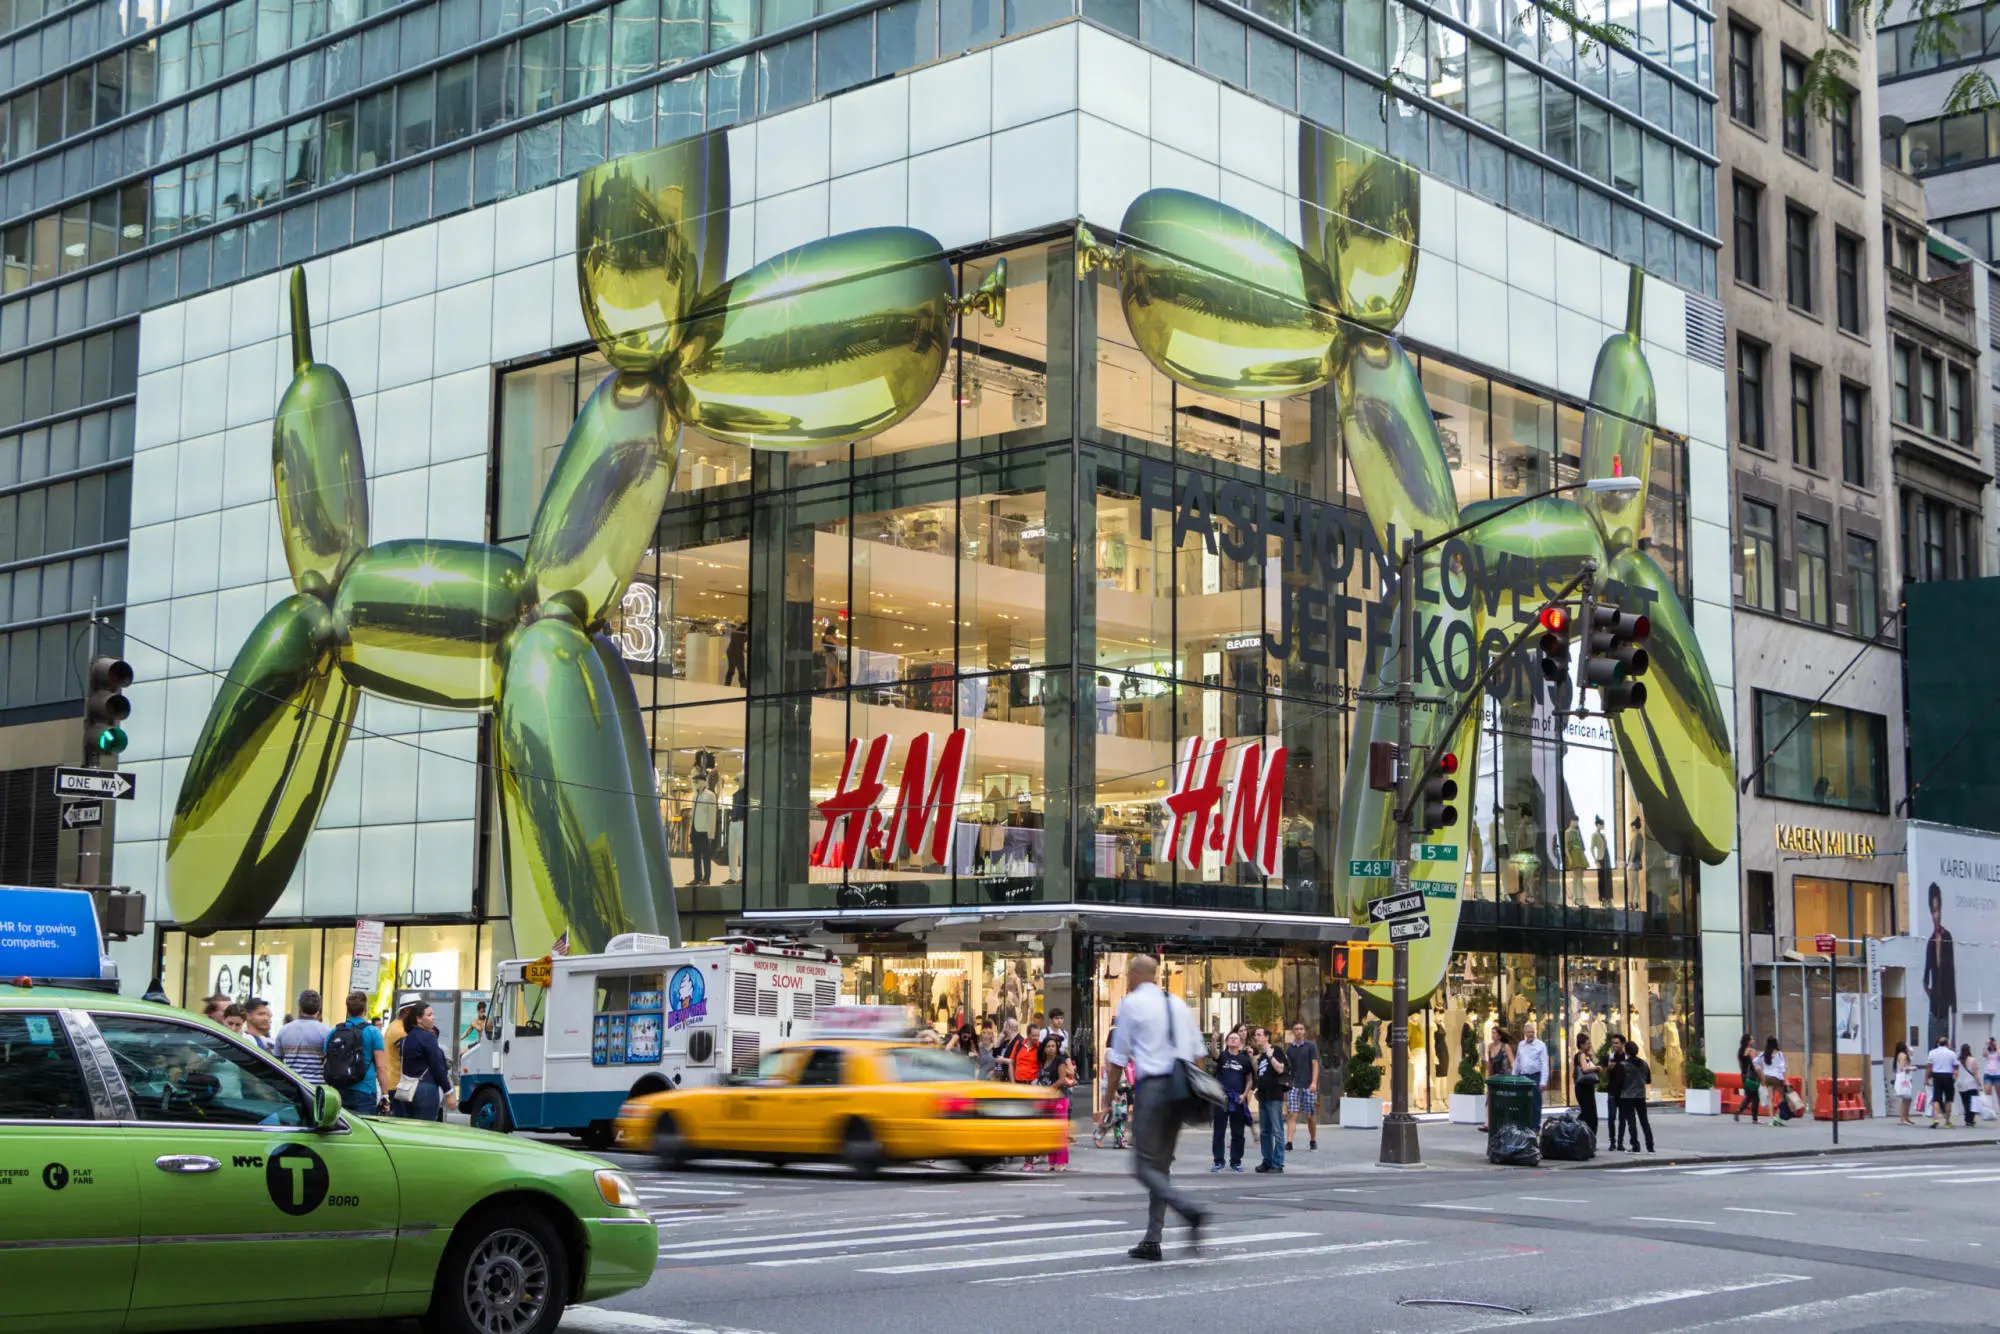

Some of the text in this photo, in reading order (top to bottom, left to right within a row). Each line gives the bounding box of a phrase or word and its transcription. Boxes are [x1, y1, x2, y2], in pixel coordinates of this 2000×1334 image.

[1140, 459, 1397, 600] FASHION
[1265, 581, 1393, 676] JEFF
[1226, 637, 1261, 650] ELEVATOR
[1543, 715, 1552, 732] of
[67, 776, 125, 791] ONE WAY
[816, 727, 971, 870] H&M
[1161, 735, 1288, 876] H&M
[69, 808, 98, 822] ONE WAY
[1775, 824, 1876, 858] KAREN MILLEN
[1427, 847, 1437, 859] 5
[1353, 862, 1361, 875] E
[1364, 862, 1382, 876] 48
[1940, 857, 1972, 879] KAREN
[1410, 880, 1431, 893] WILLIAM
[1376, 899, 1418, 916] ONE WAY
[0, 921, 77, 937] HR for growing
[1392, 923, 1426, 936] ONE WAY
[1, 937, 60, 950] companies.
[531, 966, 551, 977] SLOW
[754, 960, 826, 976] WATCH FOR OUR CHILDREN
[771, 974, 803, 989] SLOW!
[73, 1177, 94, 1185] FARE
[232, 1155, 360, 1207] NYC T BORO
